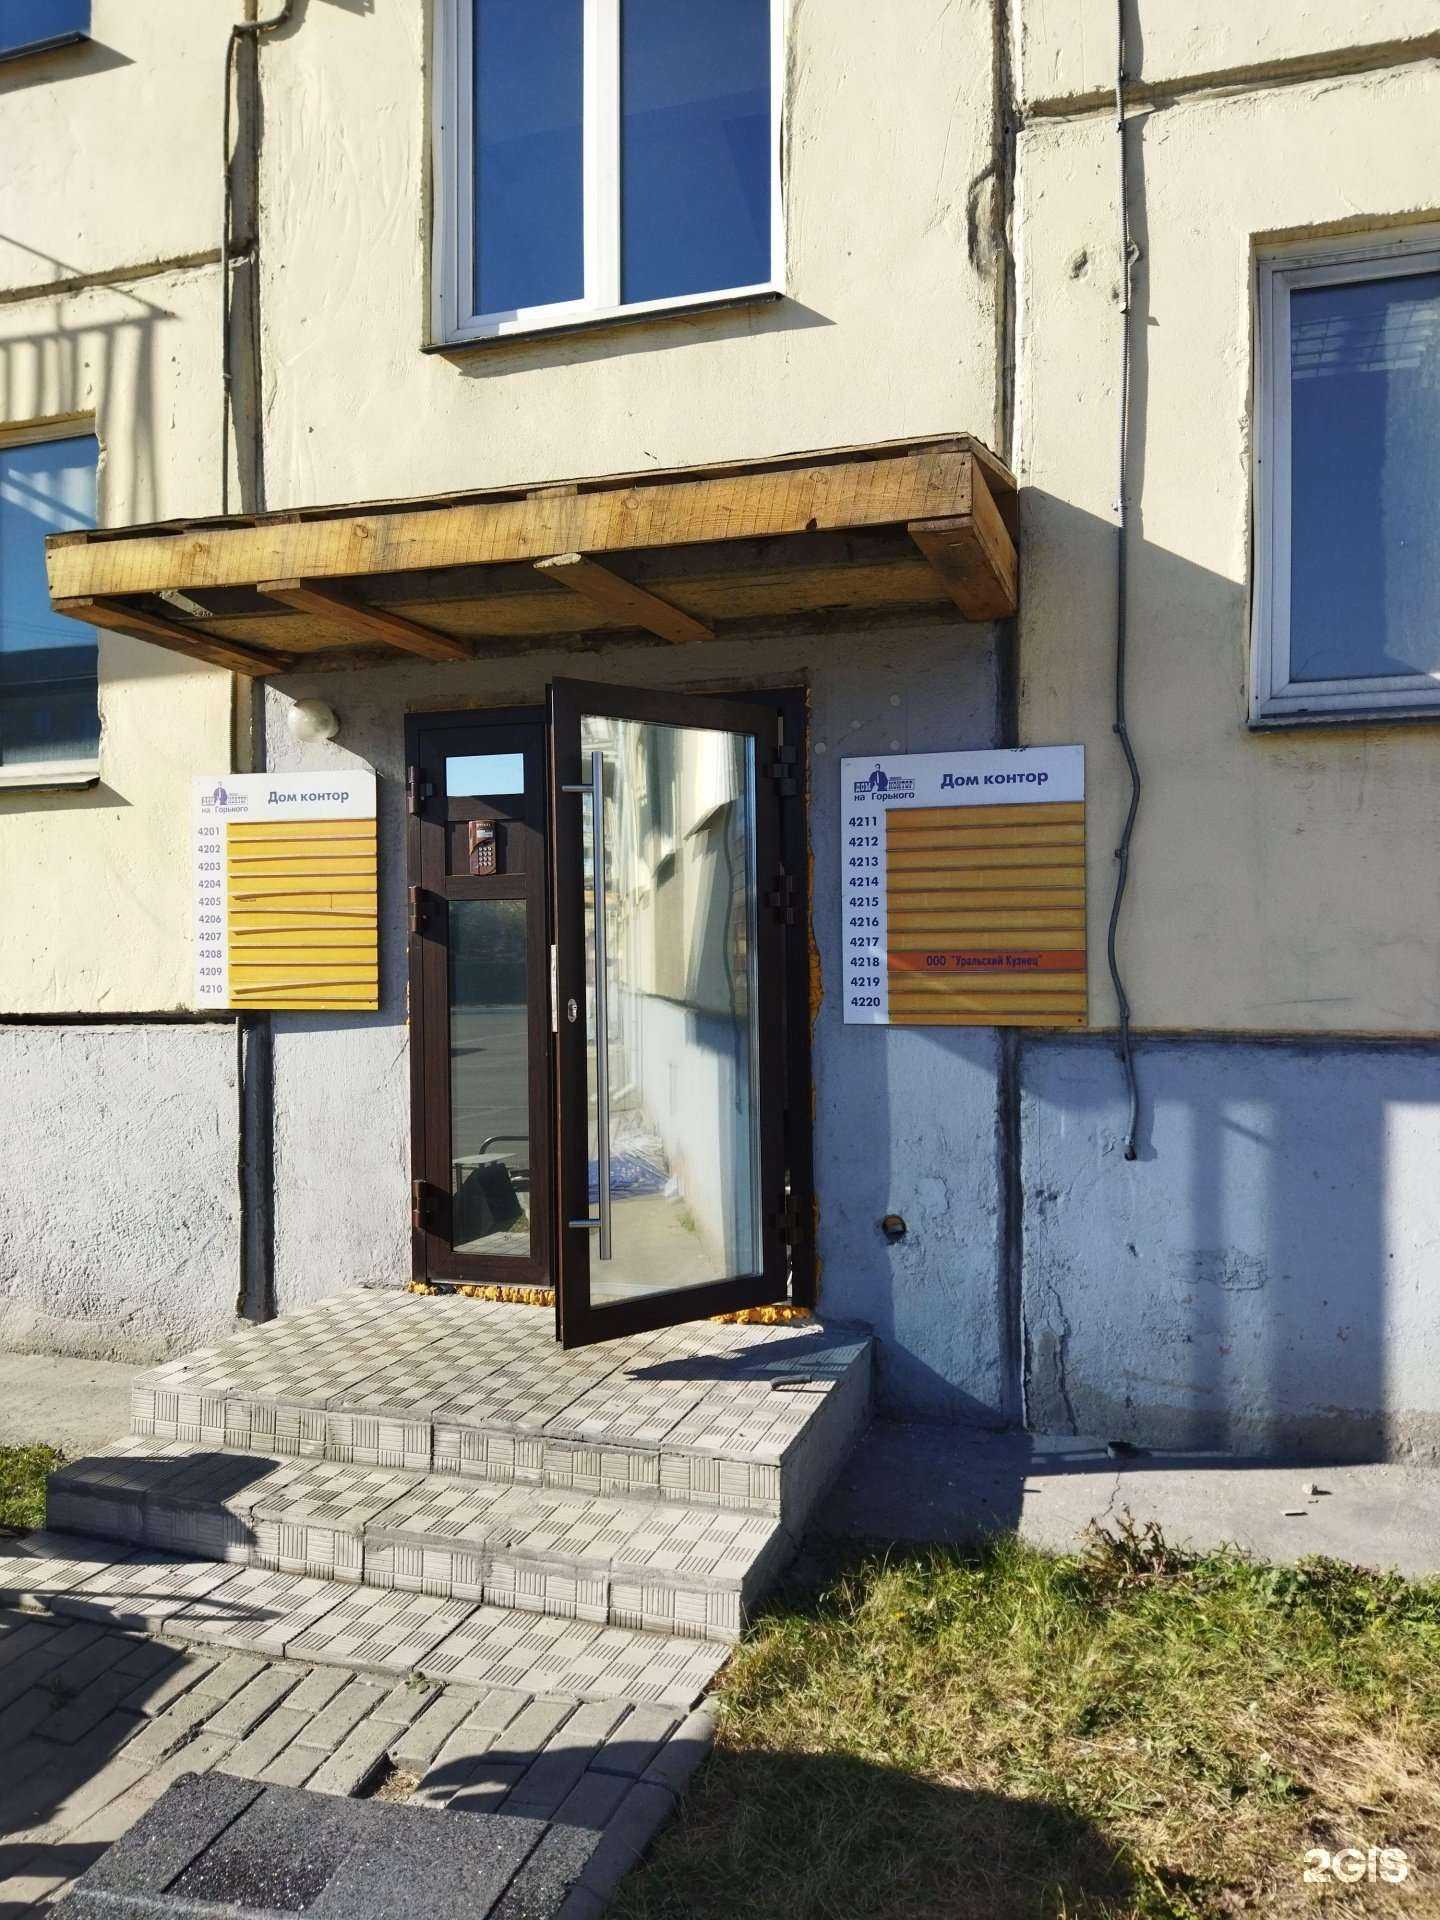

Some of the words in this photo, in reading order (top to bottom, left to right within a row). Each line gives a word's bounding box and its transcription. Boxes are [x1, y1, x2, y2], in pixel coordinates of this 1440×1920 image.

[940, 773, 979, 789] Дом
[983, 772, 1049, 787] контор
[268, 791, 297, 805] Дом
[300, 791, 350, 804] контор
[854, 794, 866, 802] на
[871, 792, 915, 802] Горького
[849, 816, 877, 827] 4211
[198, 827, 220, 836] 4201
[848, 836, 880, 847] 4212
[198, 844, 221, 853] 4202
[198, 862, 222, 871] 4203
[849, 857, 879, 867] 4213
[198, 880, 221, 889] 4204
[849, 877, 880, 887] 4214
[198, 897, 222, 906] 4205
[849, 897, 879, 907] 4215
[198, 914, 222, 924] 4206
[849, 917, 880, 927] 4216
[199, 932, 222, 941] 4207
[850, 937, 880, 947] 4217
[199, 950, 223, 959] 4208
[850, 957, 880, 967] 4218
[199, 967, 223, 976] 4209
[850, 977, 880, 987] 4219
[200, 984, 223, 994] 4210
[851, 997, 881, 1007] 4220
